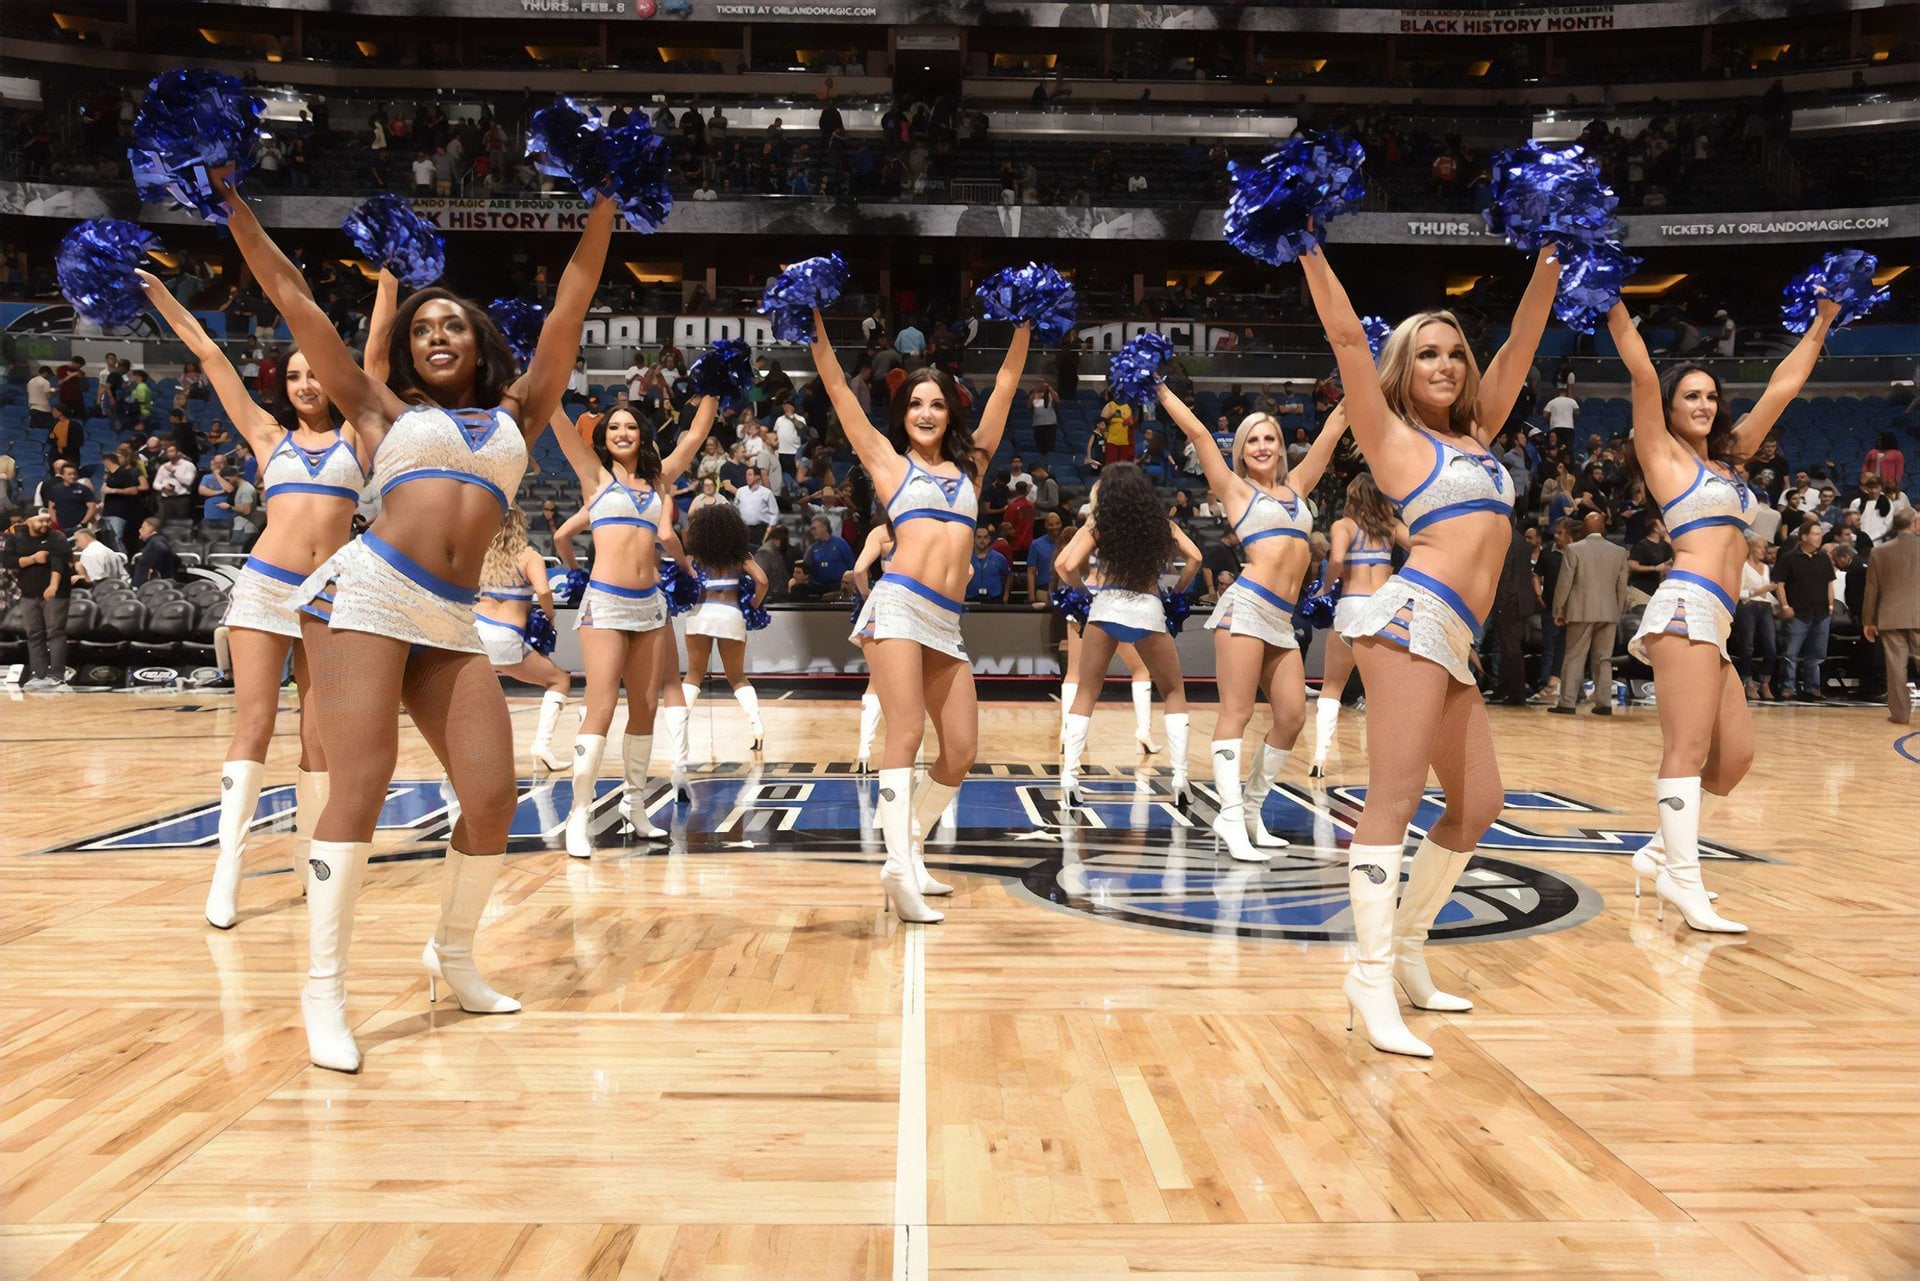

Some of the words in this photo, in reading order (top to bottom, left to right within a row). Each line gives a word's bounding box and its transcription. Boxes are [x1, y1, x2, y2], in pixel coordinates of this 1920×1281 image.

[616, 3, 625, 13] 8
[716, 5, 754, 14] TICKETS
[757, 5, 770, 14] AT
[773, 6, 877, 16] ORLANDOMAGIC.COM
[1401, 20, 1458, 32] BLACK
[1463, 18, 1541, 33] HISTORY
[1547, 15, 1614, 31] MONTH
[449, 200, 485, 208] MAGIC
[489, 200, 512, 208] ARE
[515, 200, 554, 209] PROUD
[558, 200, 573, 209] TO
[449, 212, 550, 228] HISTORY
[1661, 225, 1714, 235] TICKETS
[1717, 224, 1736, 234] AT
[1738, 218, 1889, 234] ORLANDOMAGIC.COM
